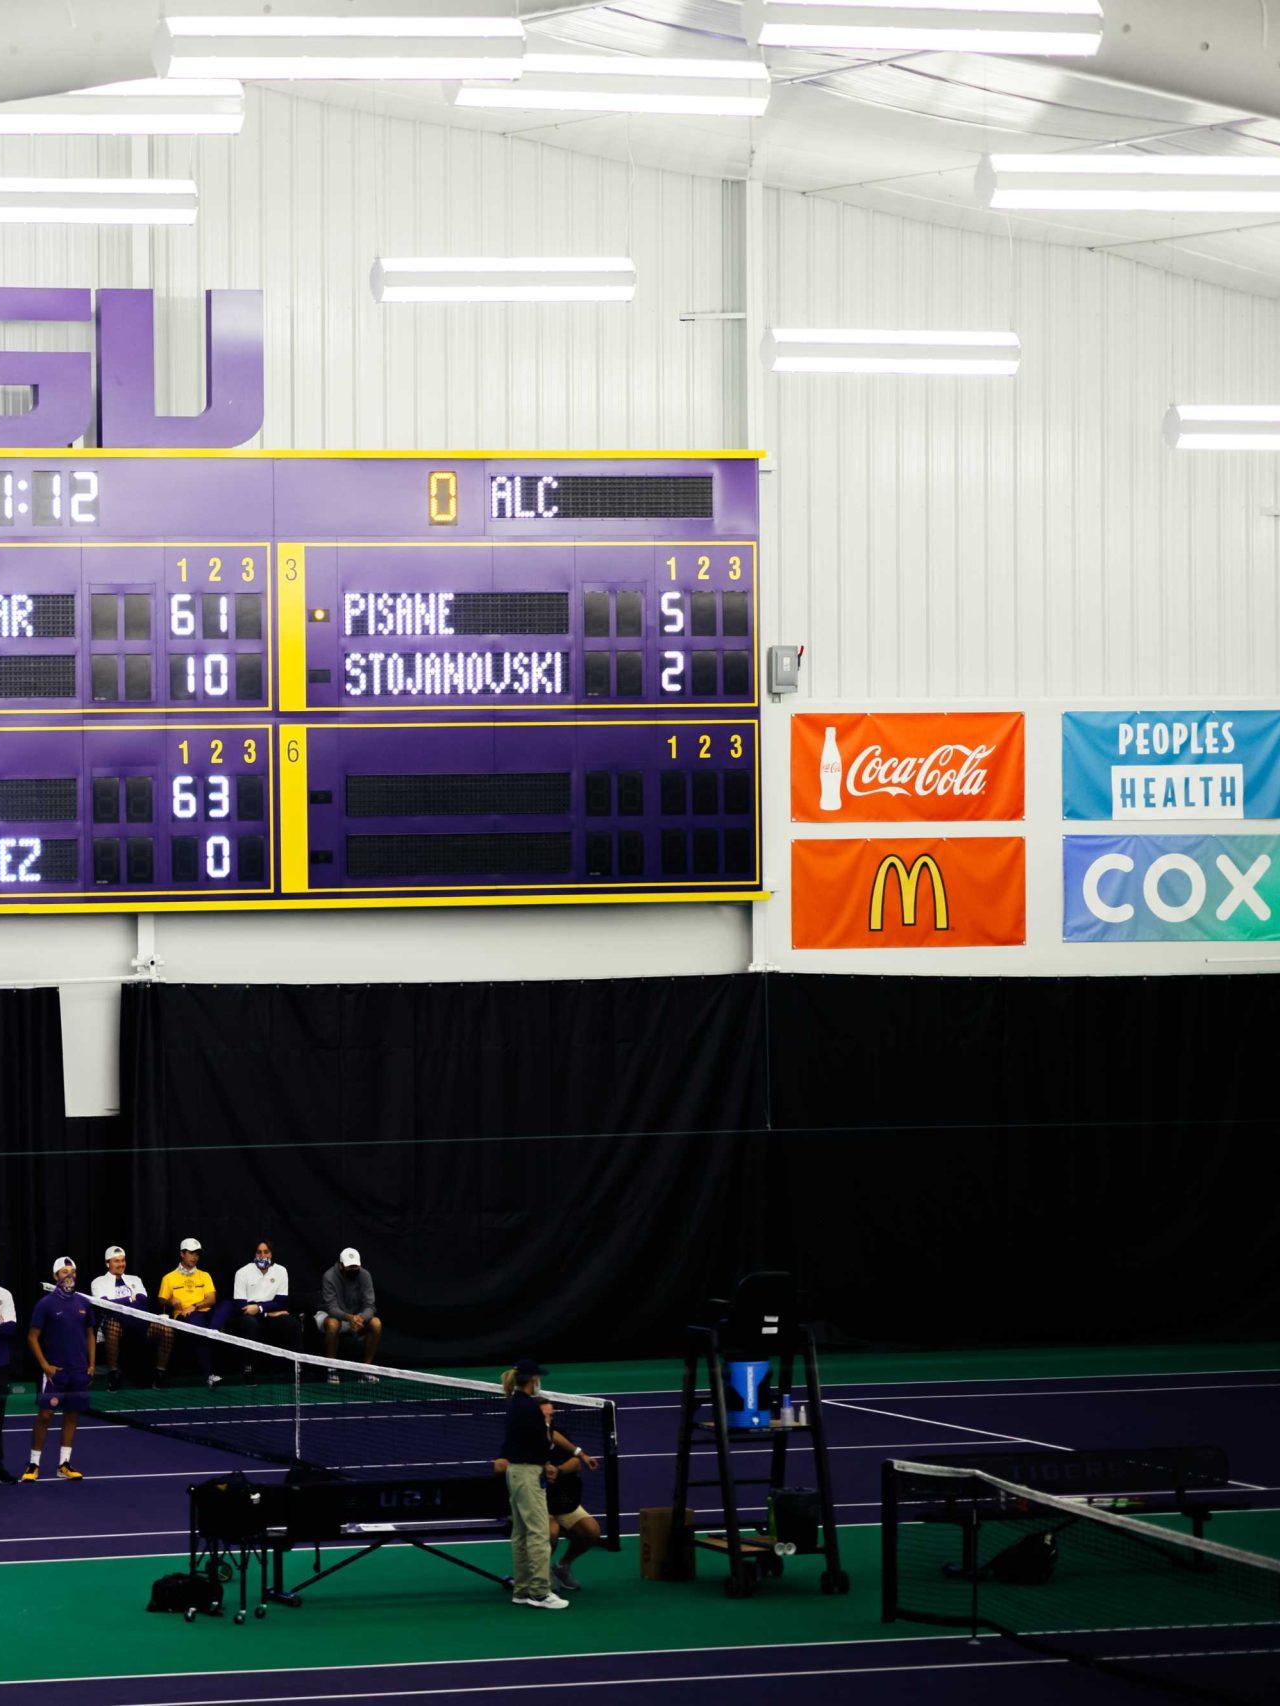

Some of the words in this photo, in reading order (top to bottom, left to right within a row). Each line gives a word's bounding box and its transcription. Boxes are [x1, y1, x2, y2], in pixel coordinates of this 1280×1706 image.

[491, 476, 558, 518] ALC
[177, 558, 188, 583] 1
[208, 558, 222, 582] 2
[241, 557, 255, 581] 3
[286, 558, 298, 581] 3
[666, 556, 677, 580] 1
[698, 556, 710, 580] 2
[728, 556, 742, 580] 3
[344, 592, 454, 635] PISANE
[661, 592, 683, 632] 5
[345, 652, 561, 695] STOJANOVSKI
[662, 651, 684, 691] 2
[178, 740, 189, 764] 1
[210, 740, 223, 764] 2
[243, 739, 256, 763] 3
[287, 740, 300, 763] 6
[667, 736, 677, 759] 1
[699, 735, 711, 758] 2
[730, 735, 742, 758] 3
[1119, 722, 1235, 755] PEOPLES
[846, 744, 997, 797] Coca-Cola
[1120, 775, 1236, 809] HEALTH
[206, 836, 230, 877] 0
[1083, 853, 1271, 923] COX
